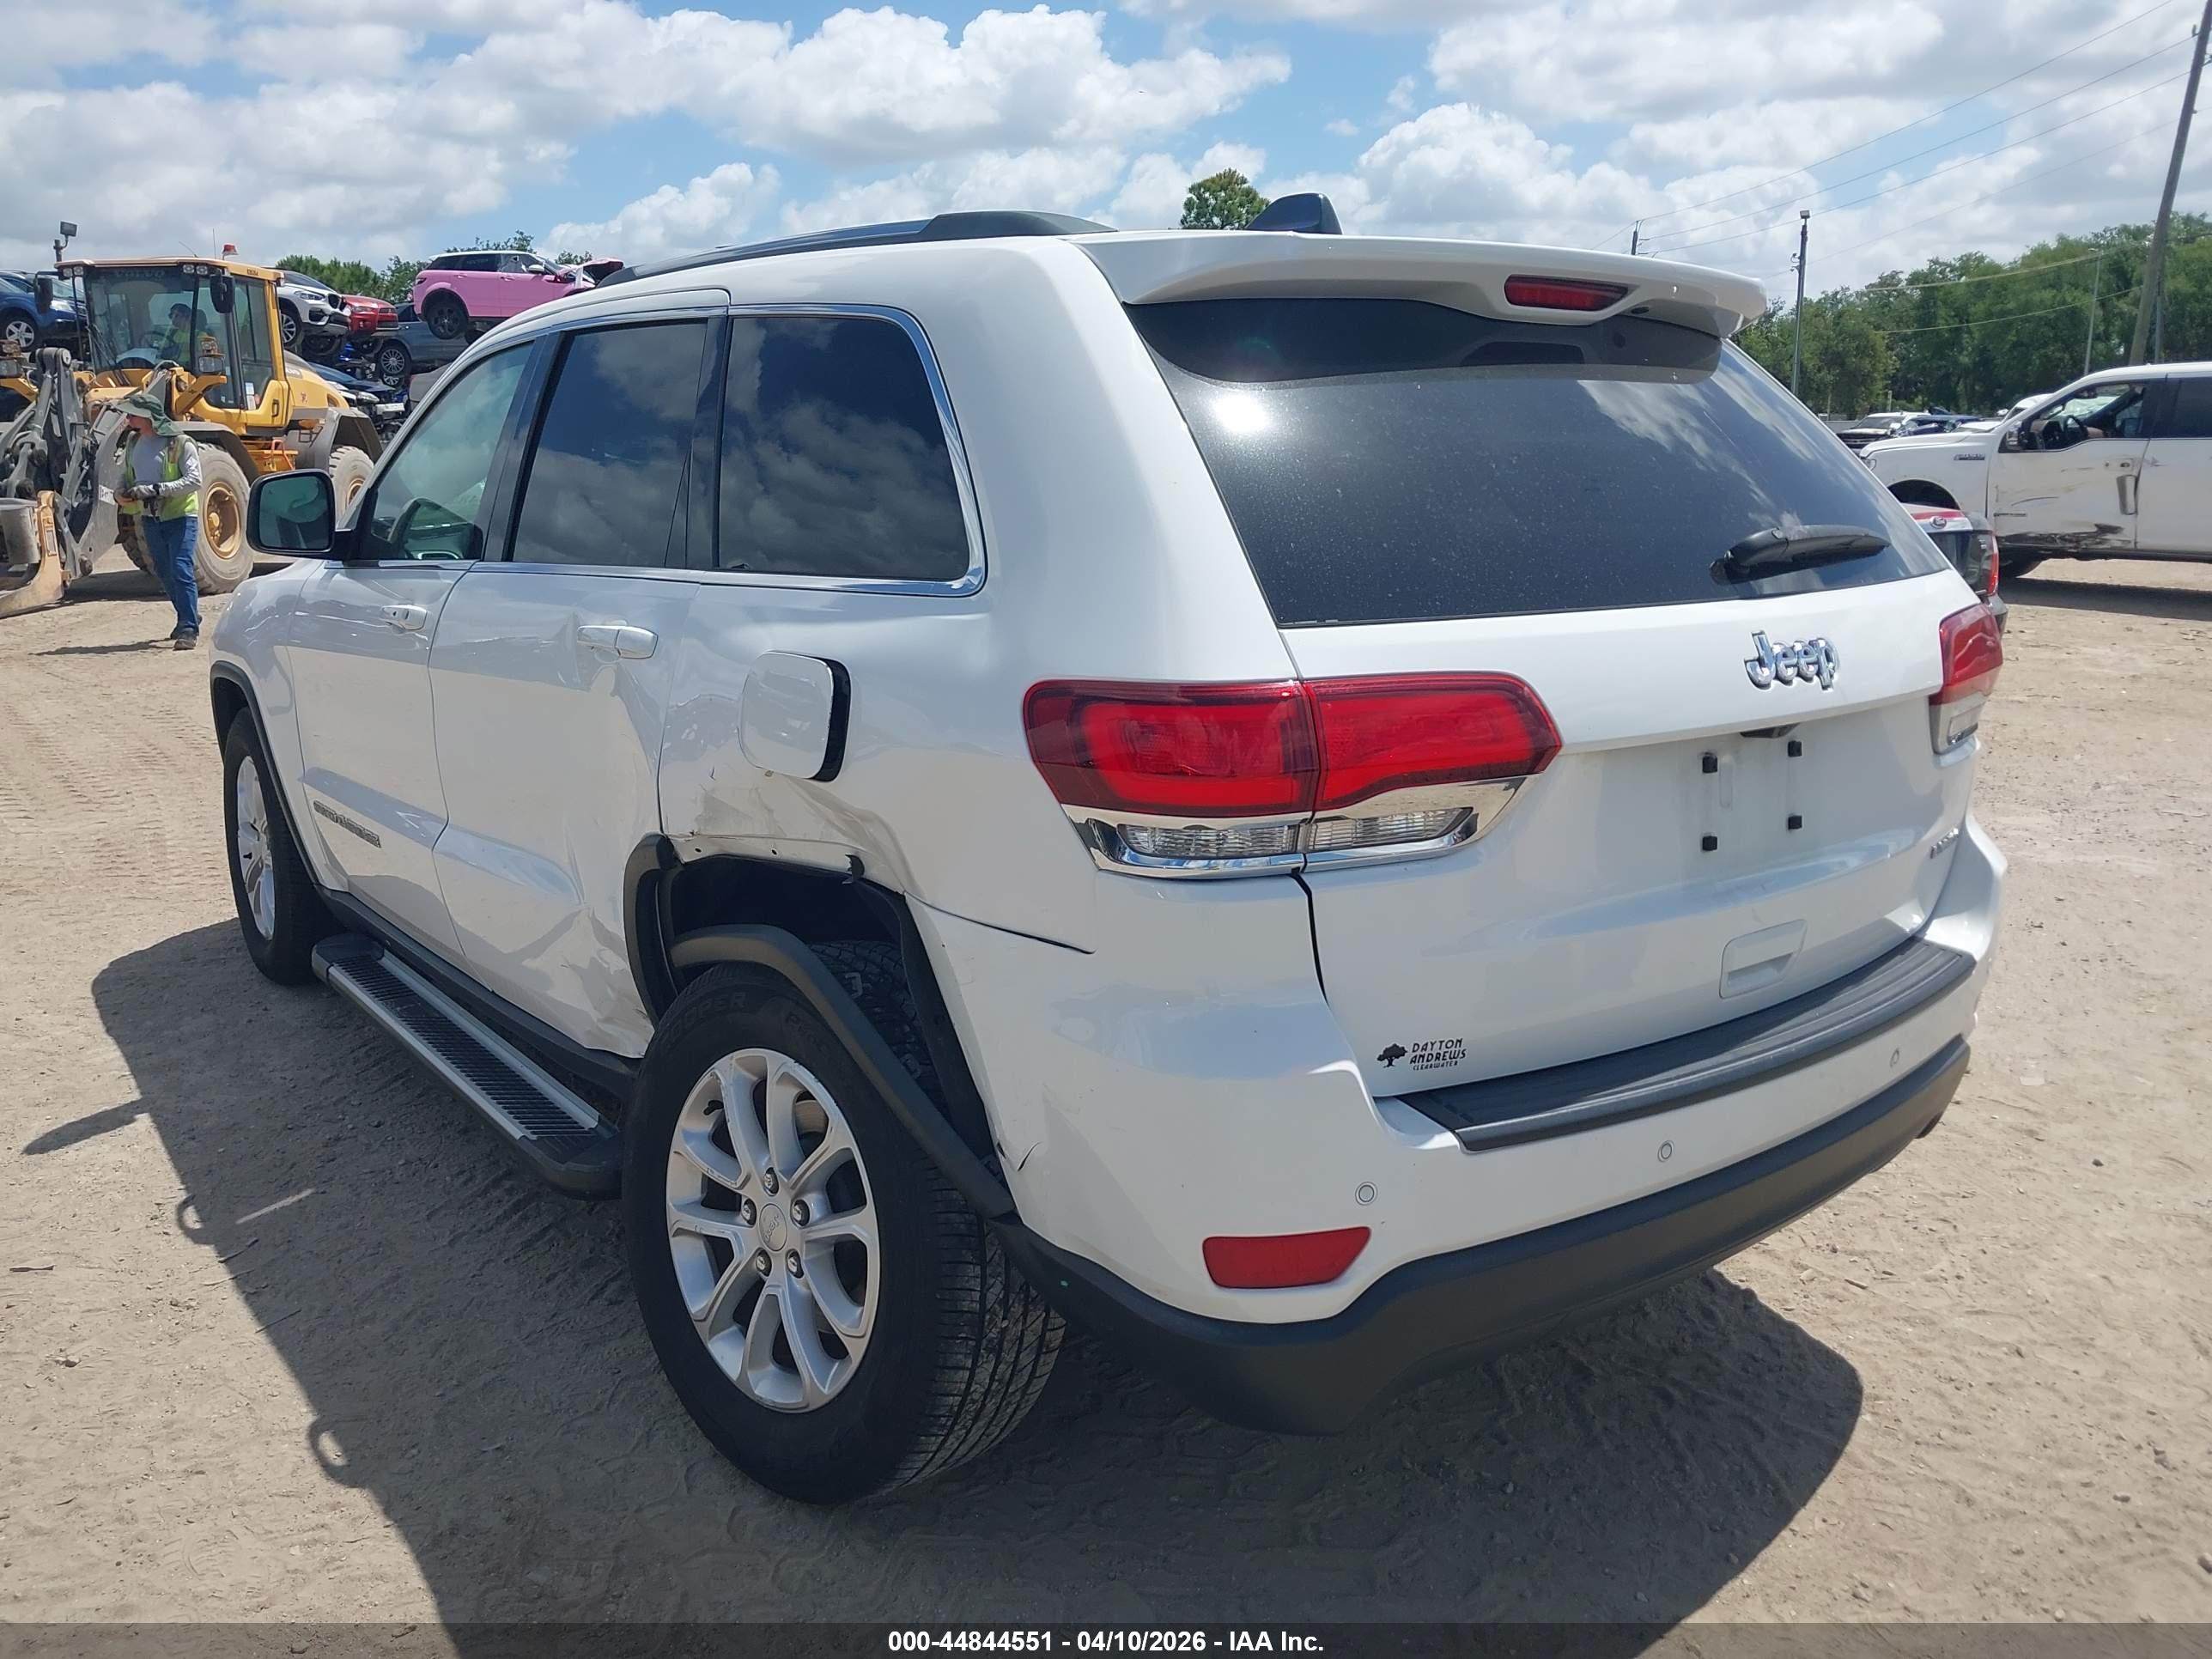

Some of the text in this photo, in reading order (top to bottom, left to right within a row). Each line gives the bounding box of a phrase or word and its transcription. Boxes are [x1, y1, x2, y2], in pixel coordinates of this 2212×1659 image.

[1744, 629, 1839, 691] Jeep
[1412, 1037, 1463, 1053] DAYTON
[1409, 1048, 1467, 1064] ANDREWS
[1413, 1060, 1458, 1071] CLEARWATER
